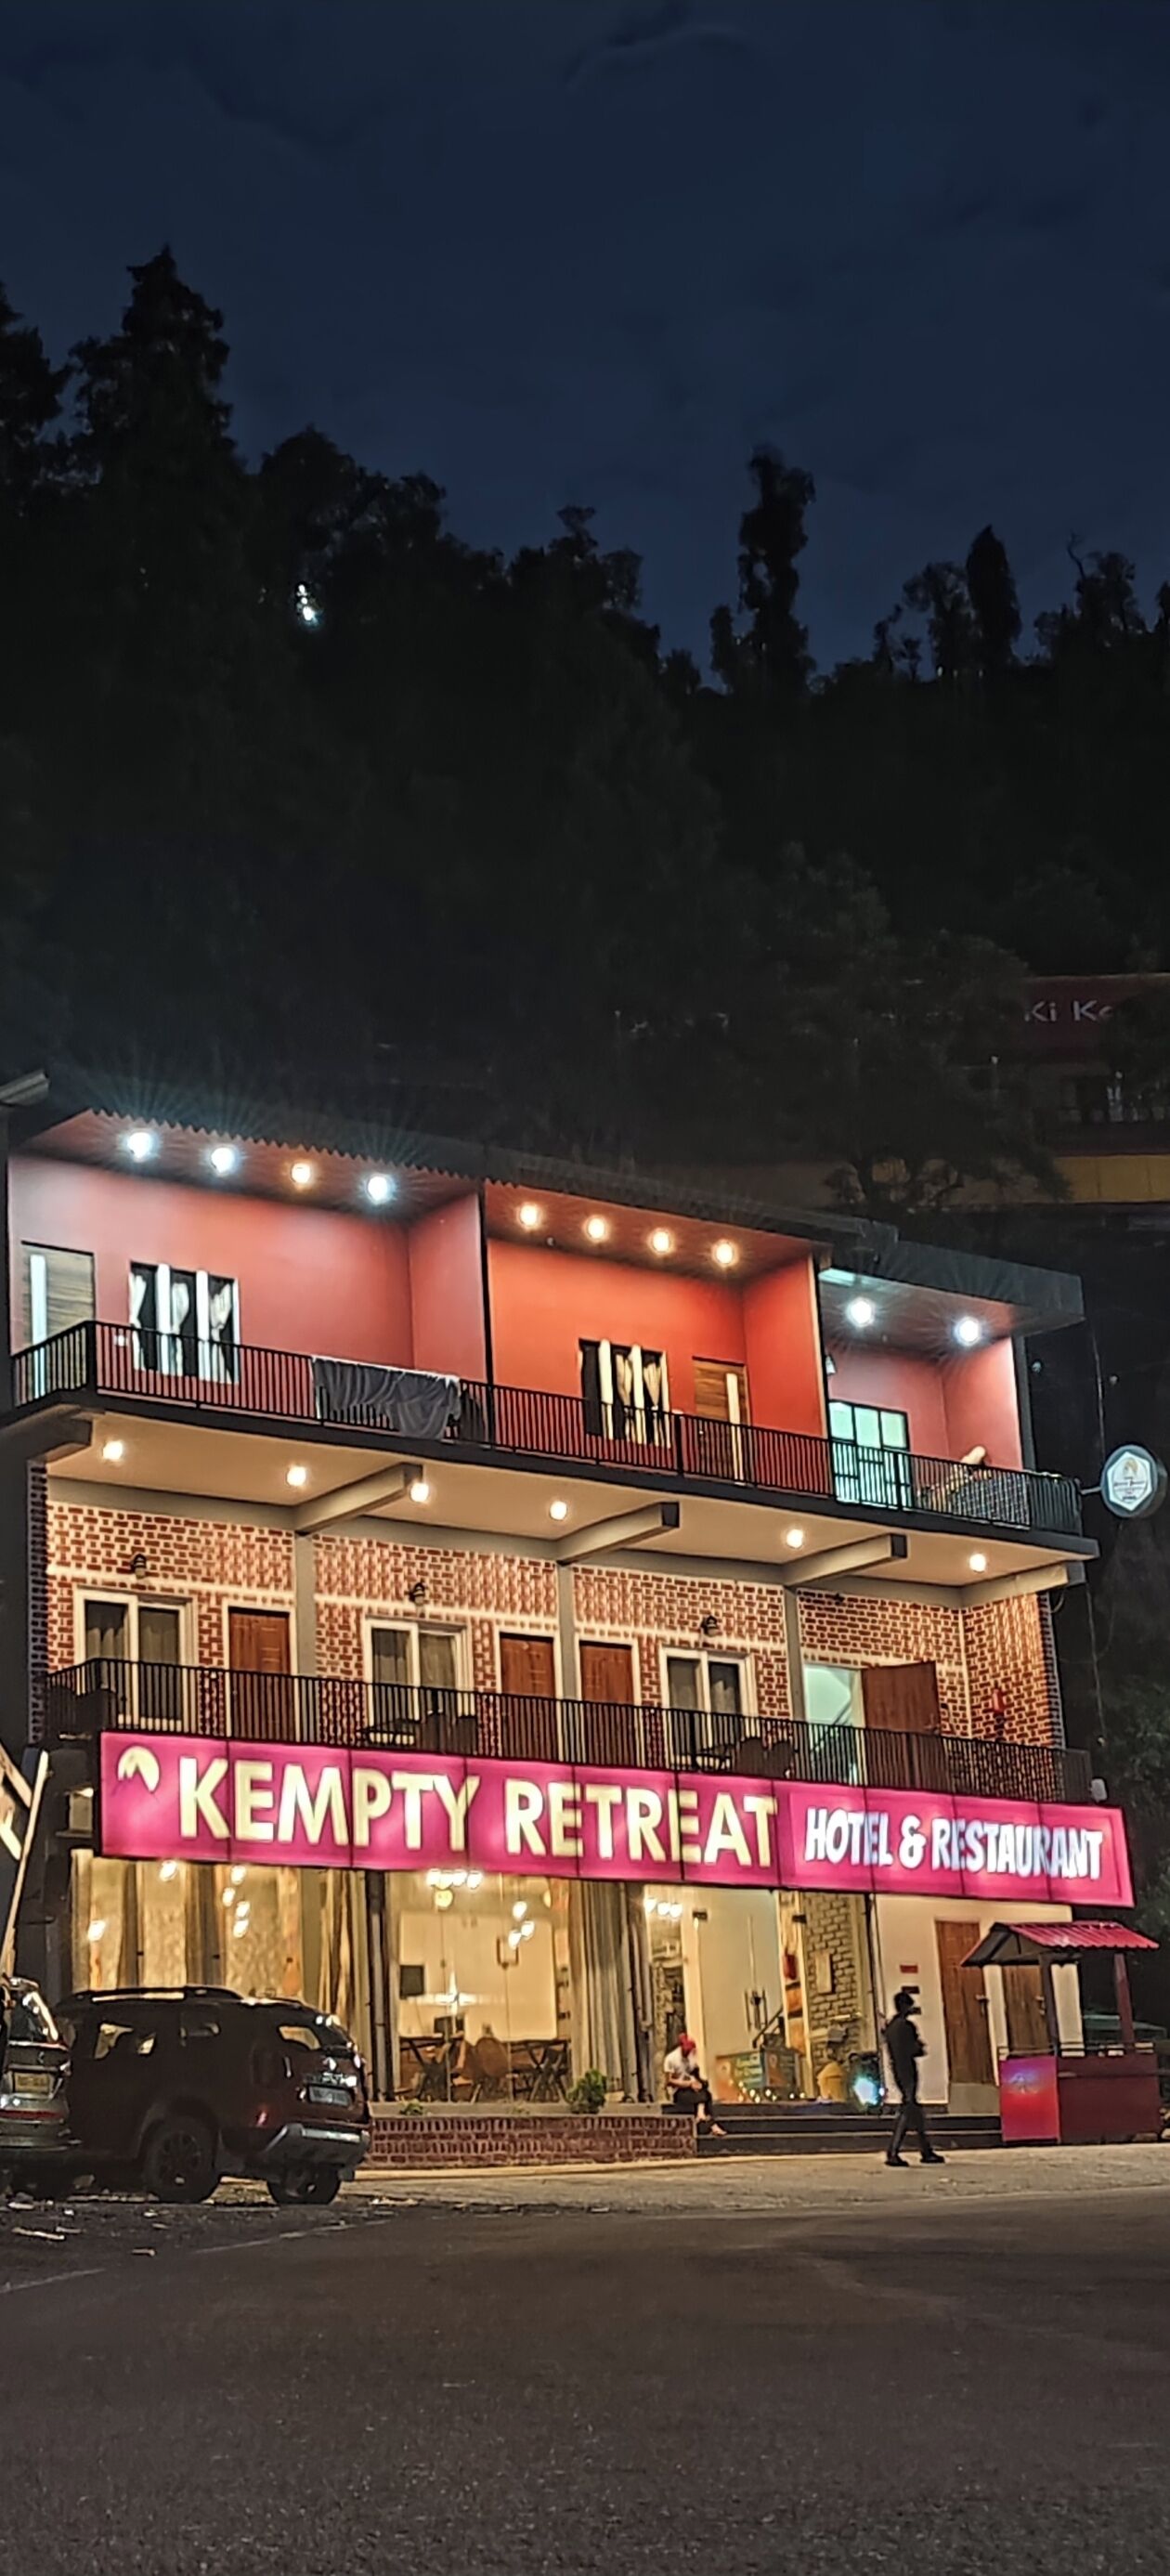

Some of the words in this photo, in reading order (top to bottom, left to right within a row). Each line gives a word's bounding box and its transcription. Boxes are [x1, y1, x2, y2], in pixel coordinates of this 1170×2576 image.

[179, 1756, 480, 1852] KEMPTY
[504, 1777, 778, 1867] RETREAT
[804, 1807, 894, 1867] HOTEL
[899, 1814, 927, 1869] &
[931, 1816, 1103, 1880] RESTAURANT
